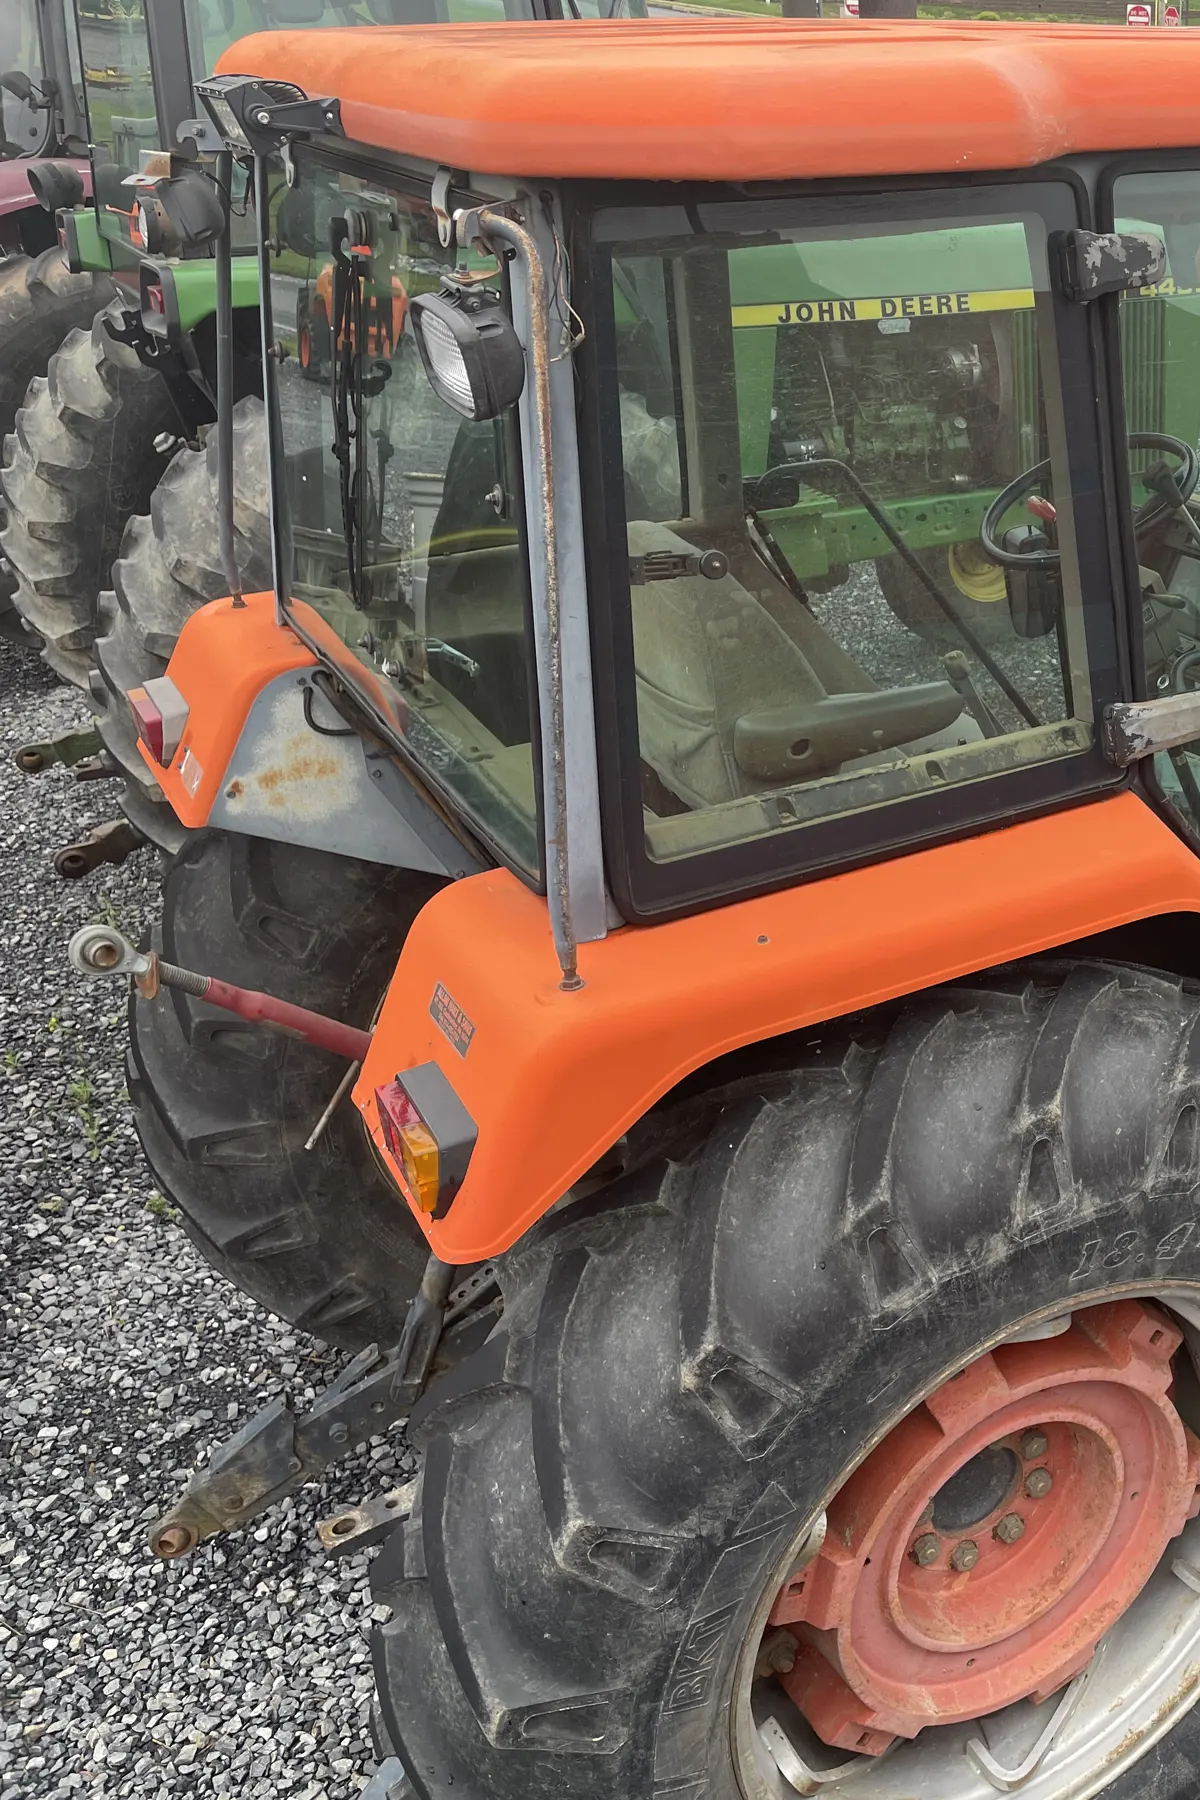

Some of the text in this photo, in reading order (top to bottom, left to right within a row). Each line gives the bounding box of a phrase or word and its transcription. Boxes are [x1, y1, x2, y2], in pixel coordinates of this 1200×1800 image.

[1164, 15, 1179, 27] STOP
[777, 293, 971, 325] JOHN DEERE
